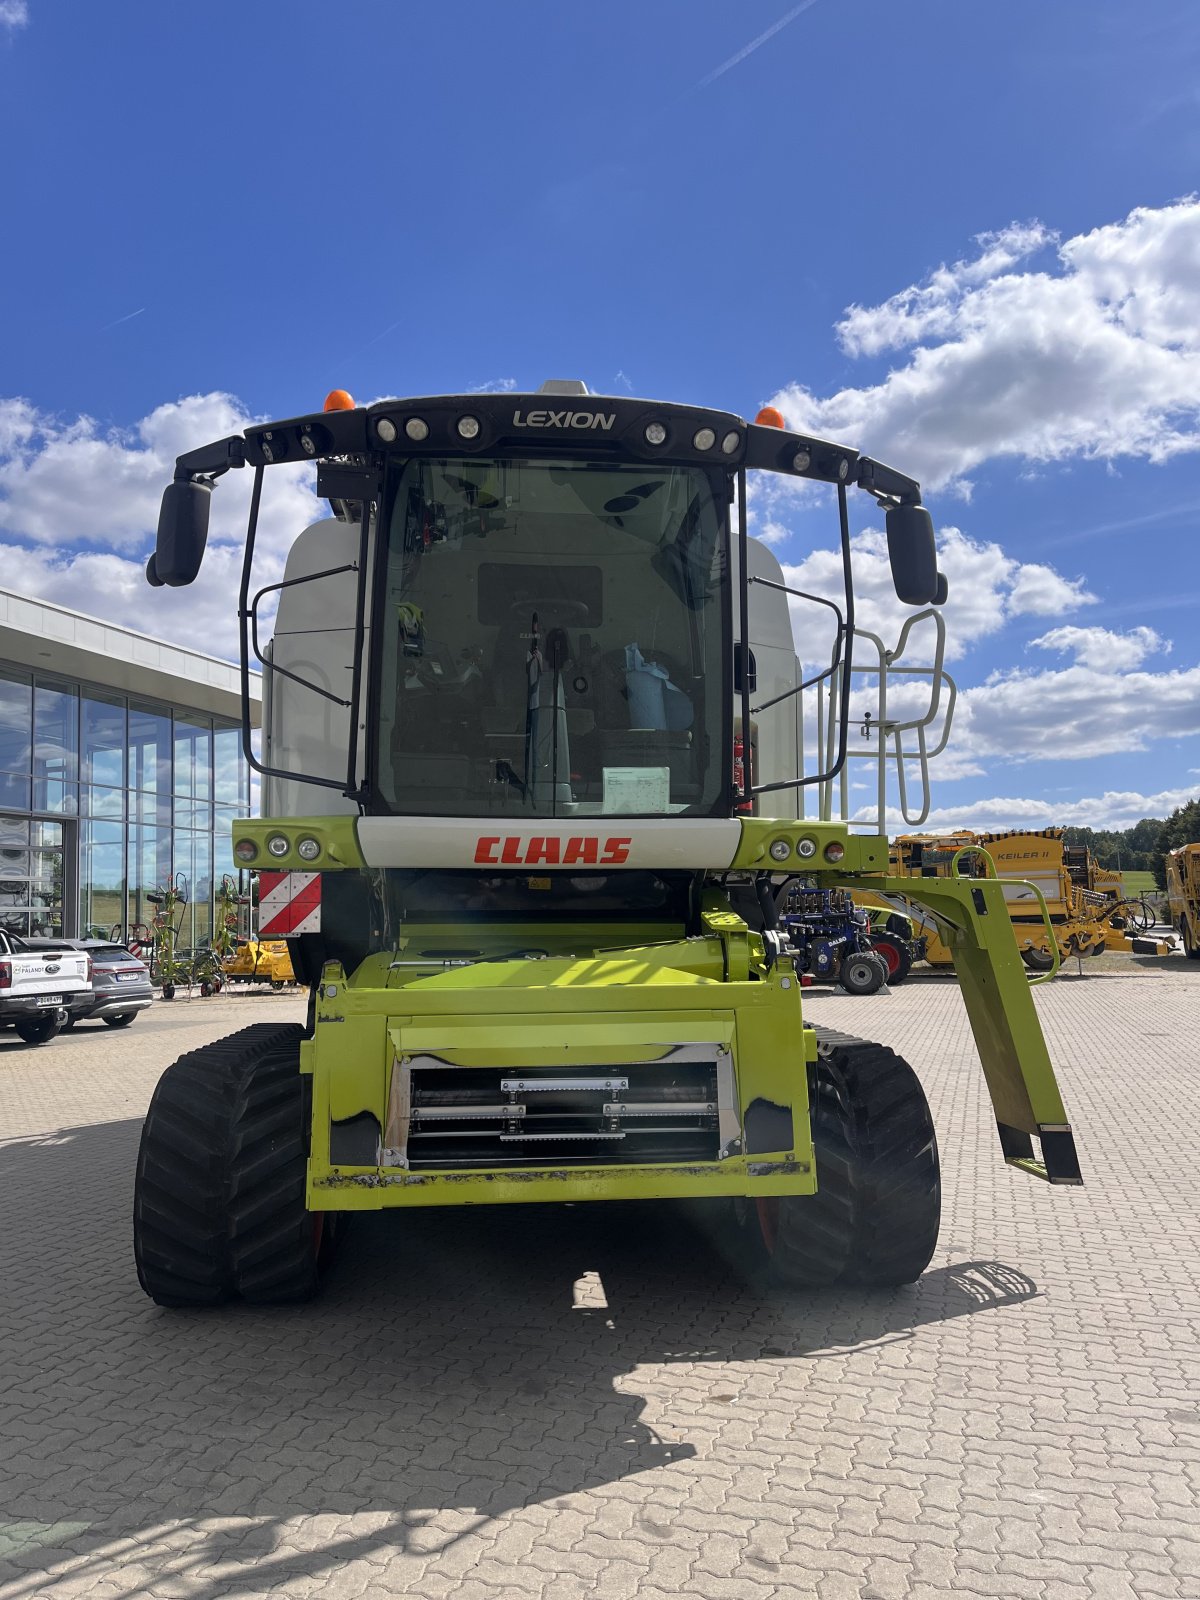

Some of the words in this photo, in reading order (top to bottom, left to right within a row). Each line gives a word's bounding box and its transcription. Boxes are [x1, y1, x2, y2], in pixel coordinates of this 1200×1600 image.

[512, 410, 616, 430] LEXION
[474, 837, 632, 864] CLAAS
[997, 851, 1039, 860] KEILER
[828, 936, 847, 948] DALBO
